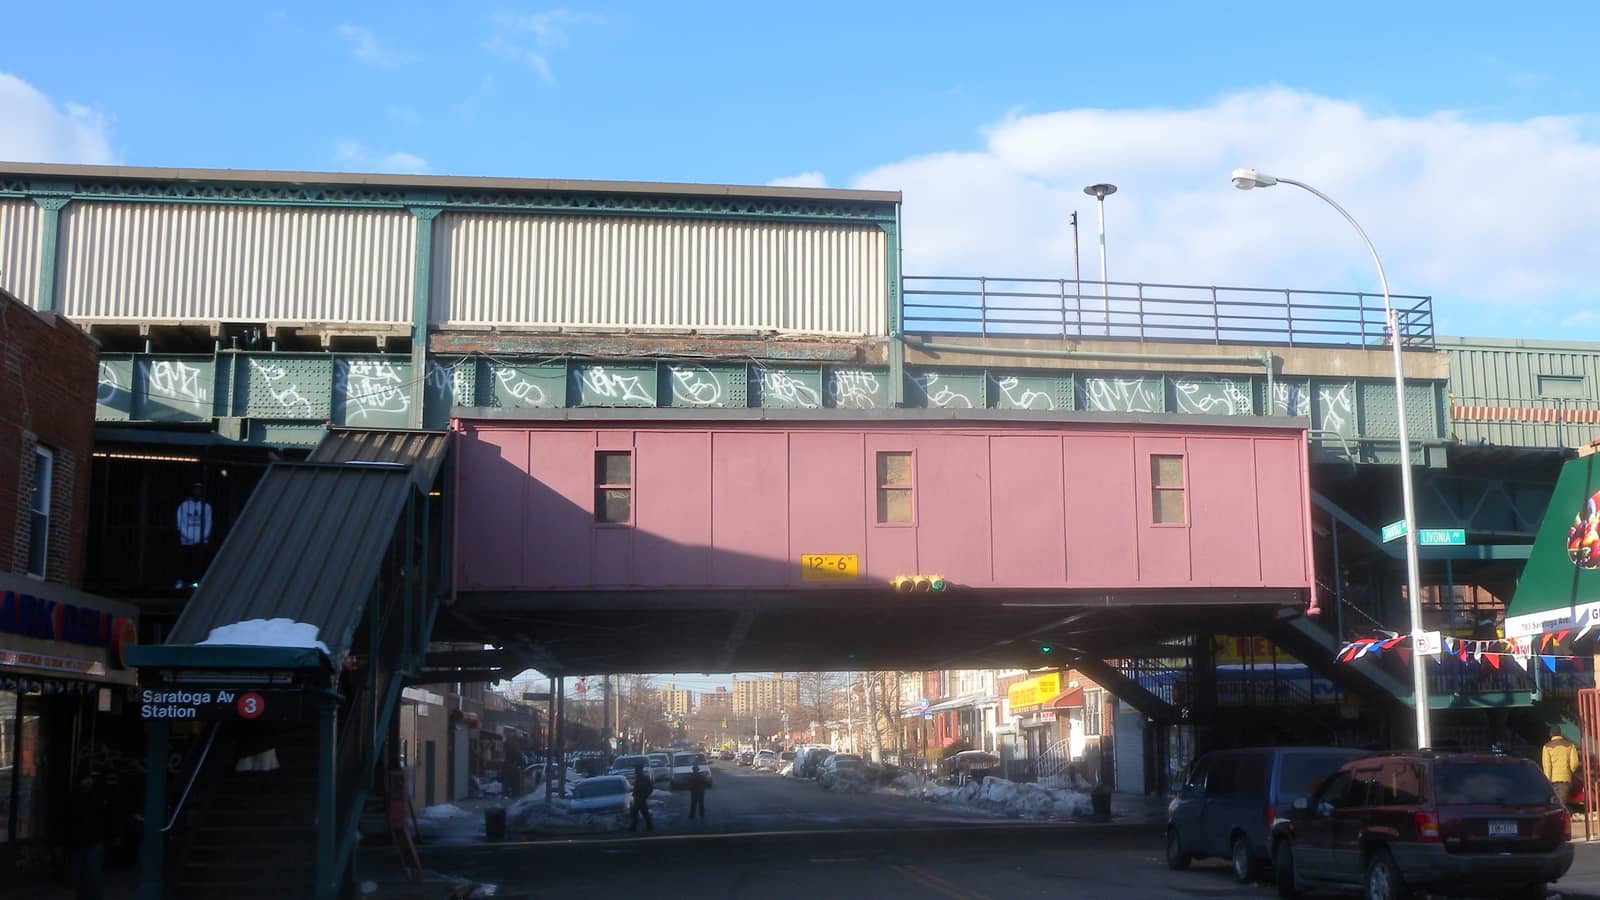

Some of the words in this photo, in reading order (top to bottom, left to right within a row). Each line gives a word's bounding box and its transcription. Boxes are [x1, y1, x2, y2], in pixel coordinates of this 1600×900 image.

[1422, 530, 1451, 543] LIVONIA
[142, 690, 211, 705] Saratoga
[216, 691, 235, 703] Av
[141, 705, 196, 718] Station
[244, 698, 257, 713] 3
